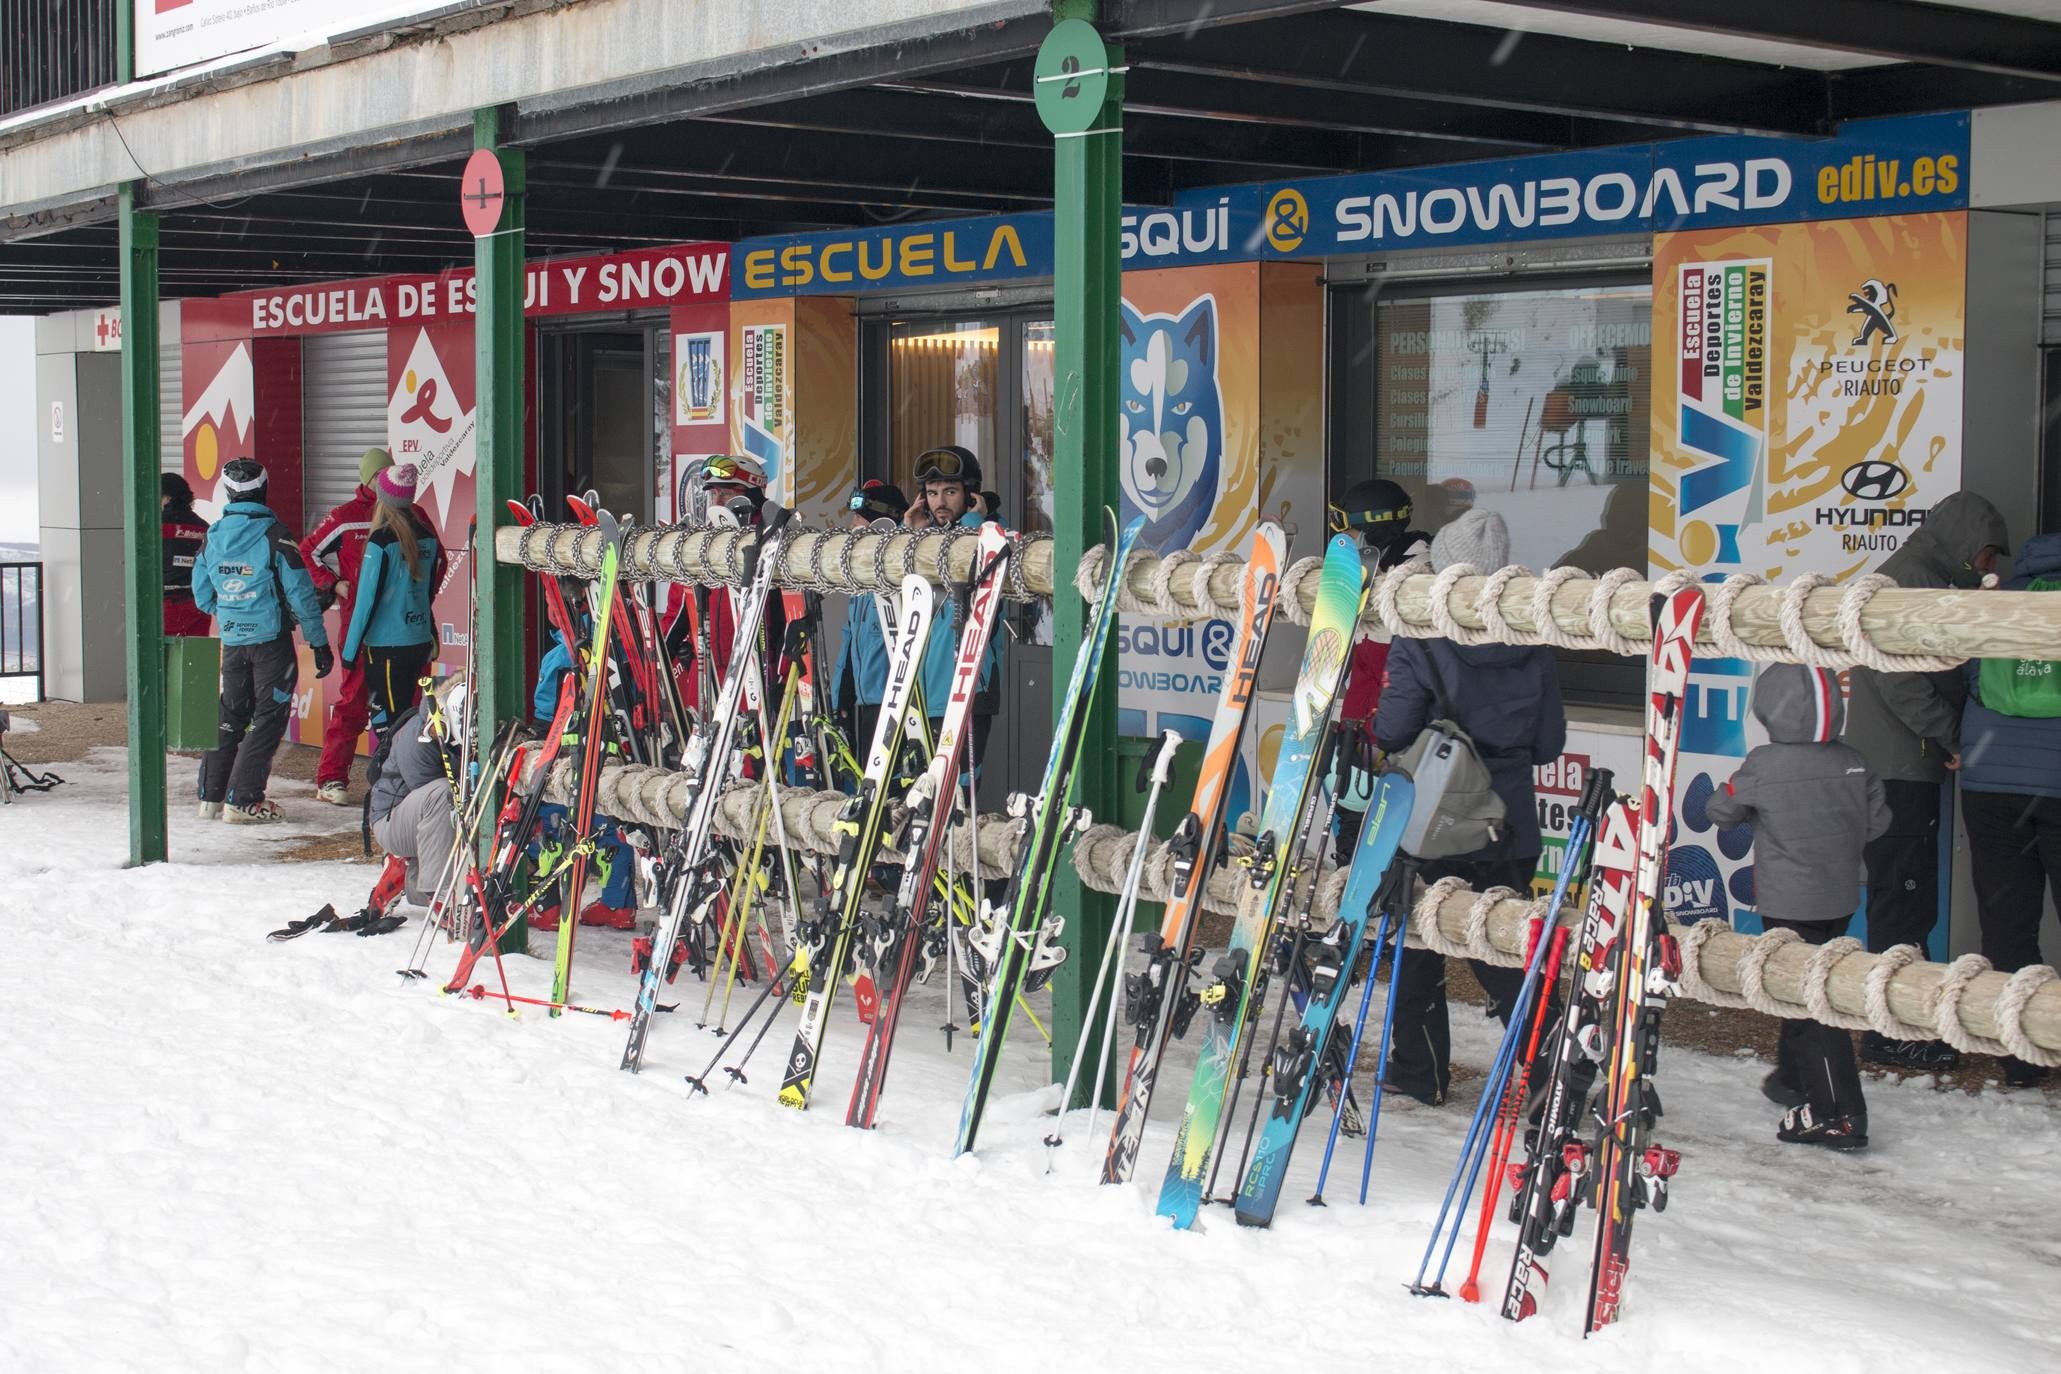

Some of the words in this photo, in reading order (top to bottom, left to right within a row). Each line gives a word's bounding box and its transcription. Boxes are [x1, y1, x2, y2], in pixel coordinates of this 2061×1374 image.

[1336, 158, 1792, 241] SNOWBOARD
[1818, 155, 1958, 204] ediv.es
[745, 225, 1028, 289] ESCUELA
[1121, 198, 1229, 258] SQUÍ
[253, 287, 387, 329] ESCUELA
[398, 281, 436, 318] DE
[563, 267, 587, 304] Y
[598, 253, 727, 302] SNOW
[1684, 273, 1701, 361] Escuela
[1704, 274, 1722, 377] Deportes
[1725, 272, 1744, 369] Invierno
[745, 333, 754, 392] Escuela
[755, 334, 764, 405] Deportes
[764, 332, 774, 401] Invierno
[1745, 270, 1765, 411] Valdezcaray
[1821, 359, 1931, 374] PEUGEOT
[775, 332, 784, 428] Valdezcaray
[1725, 375, 1744, 402] de
[1844, 379, 1900, 396] RIAUTO
[403, 440, 419, 452] EPV
[1842, 534, 1897, 551] RIAUTO
[887, 610, 920, 708] HEAD
[952, 550, 998, 702] HEAD
[1232, 573, 1277, 703] HEAD
[1118, 669, 1222, 694] OWBOAR
[1664, 879, 1714, 908] DiV
[1548, 1080, 1564, 1135] ATOMIC
